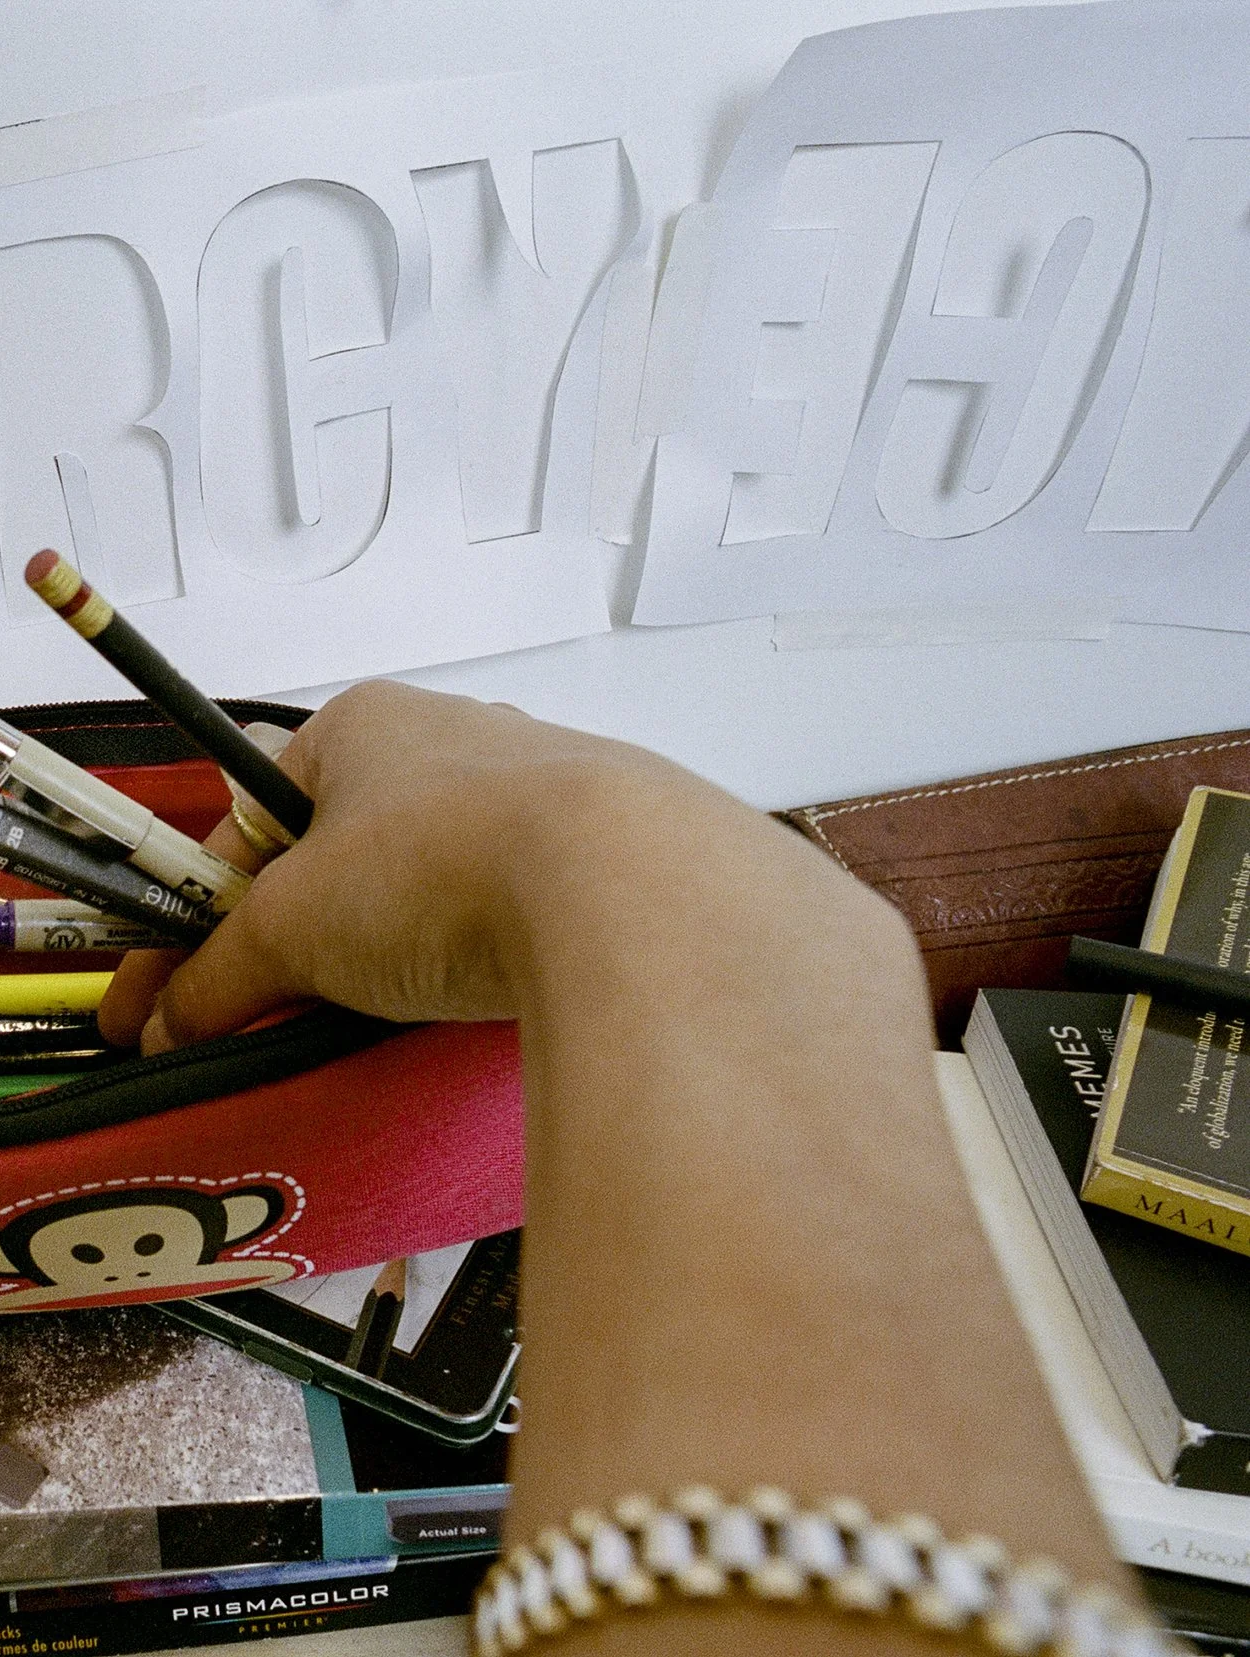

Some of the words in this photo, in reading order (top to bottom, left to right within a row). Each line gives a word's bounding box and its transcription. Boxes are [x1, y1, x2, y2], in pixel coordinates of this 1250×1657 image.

[6, 826, 24, 850] 2B
[1182, 1052, 1210, 1096] eloquent
[1230, 887, 1246, 899] in
[1225, 1024, 1244, 1052] need
[1224, 1052, 1238, 1067] we
[1202, 1130, 1221, 1150] of
[418, 1525, 458, 1539] Actual
[461, 1524, 487, 1536] Size
[171, 1583, 389, 1622] PRISMACOLOR
[238, 1616, 326, 1635] PREMIER
[32, 1639, 48, 1652] de
[51, 1636, 99, 1651] couleur
